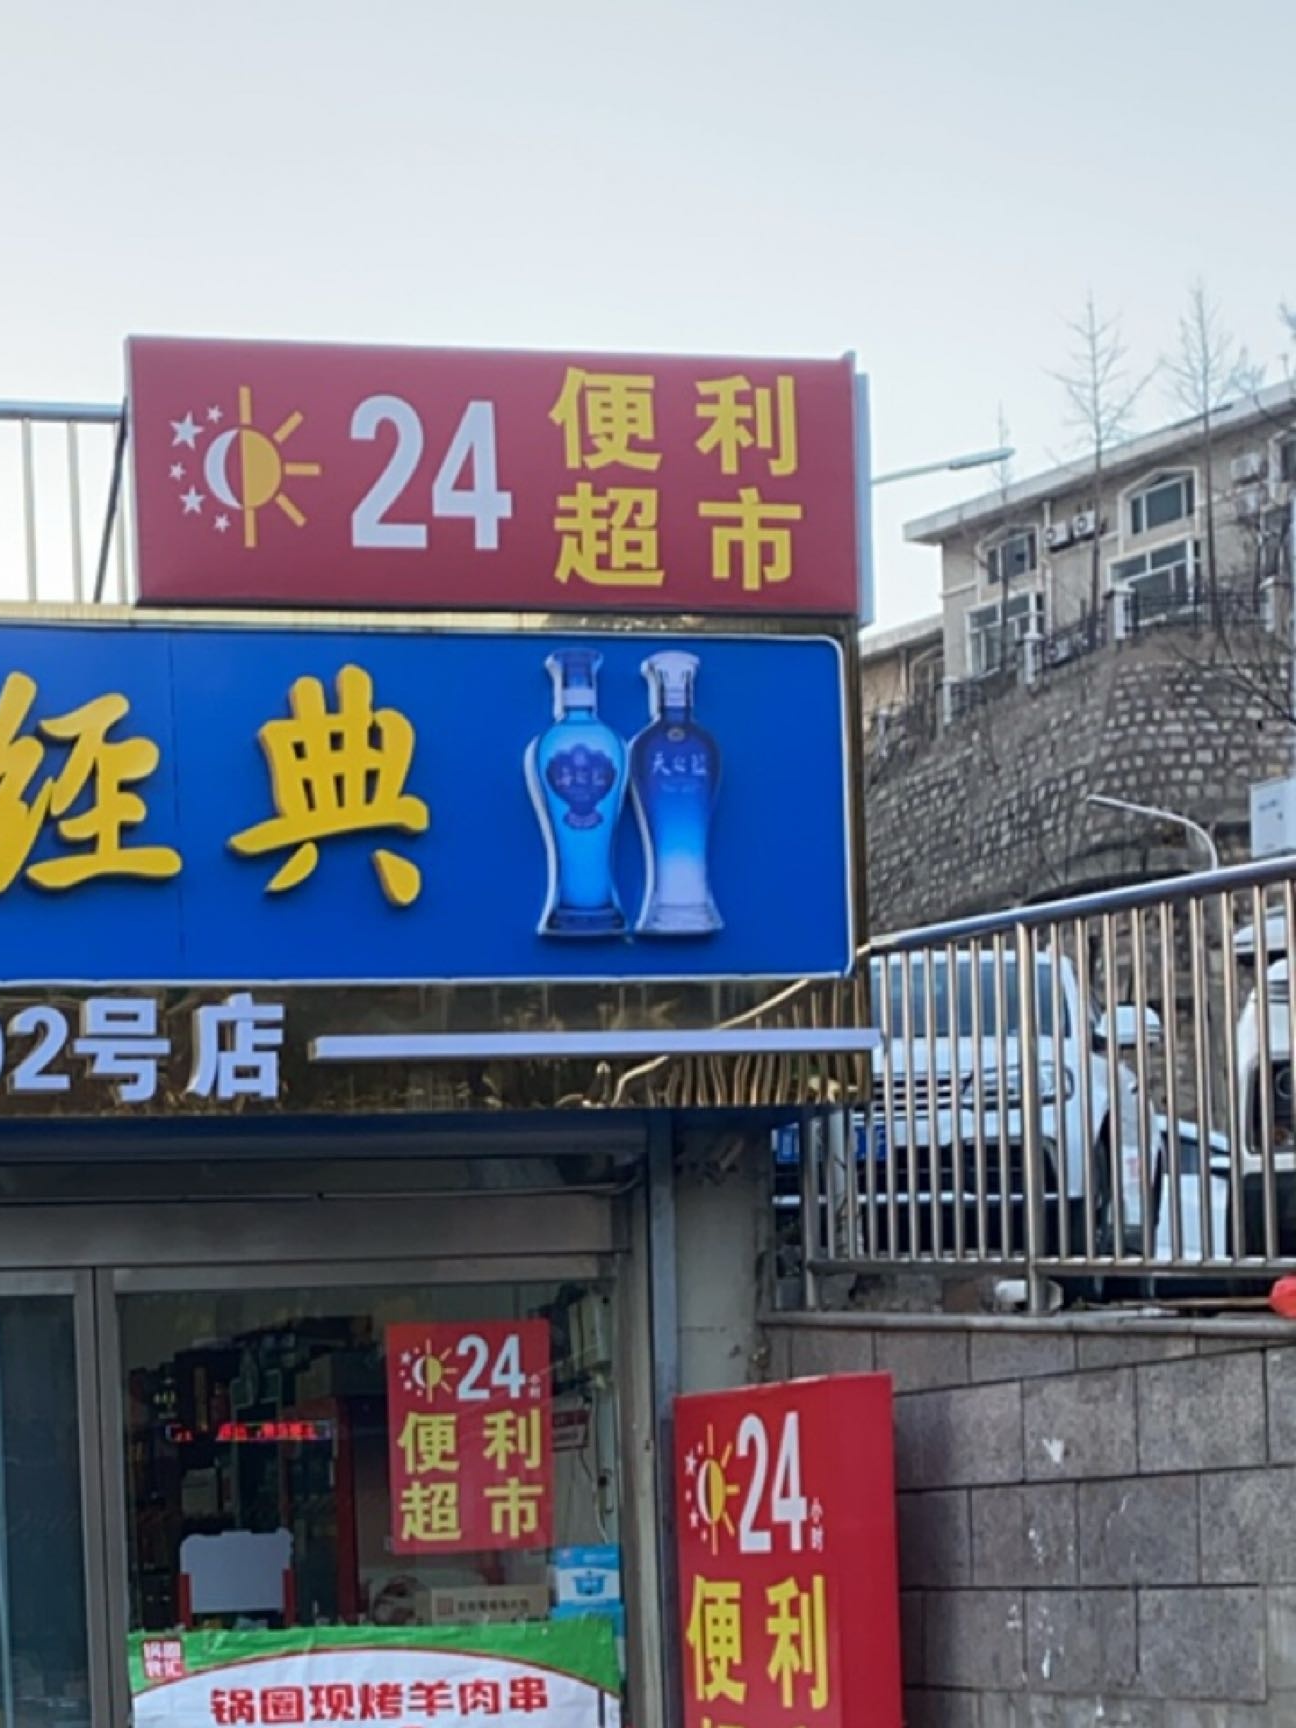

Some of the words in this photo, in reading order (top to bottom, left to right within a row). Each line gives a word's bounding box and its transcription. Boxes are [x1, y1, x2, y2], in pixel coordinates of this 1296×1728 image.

[349, 394, 512, 550] 24
[549, 366, 798, 476] 便利
[553, 483, 802, 590] 超市
[456, 1334, 525, 1400] 24
[397, 1407, 541, 1473] 便利
[736, 1411, 807, 1554] 24
[400, 1477, 544, 1541] 超市
[686, 1573, 829, 1708] 便利
[210, 1676, 549, 1726] 锅圈现烤羊肉串
